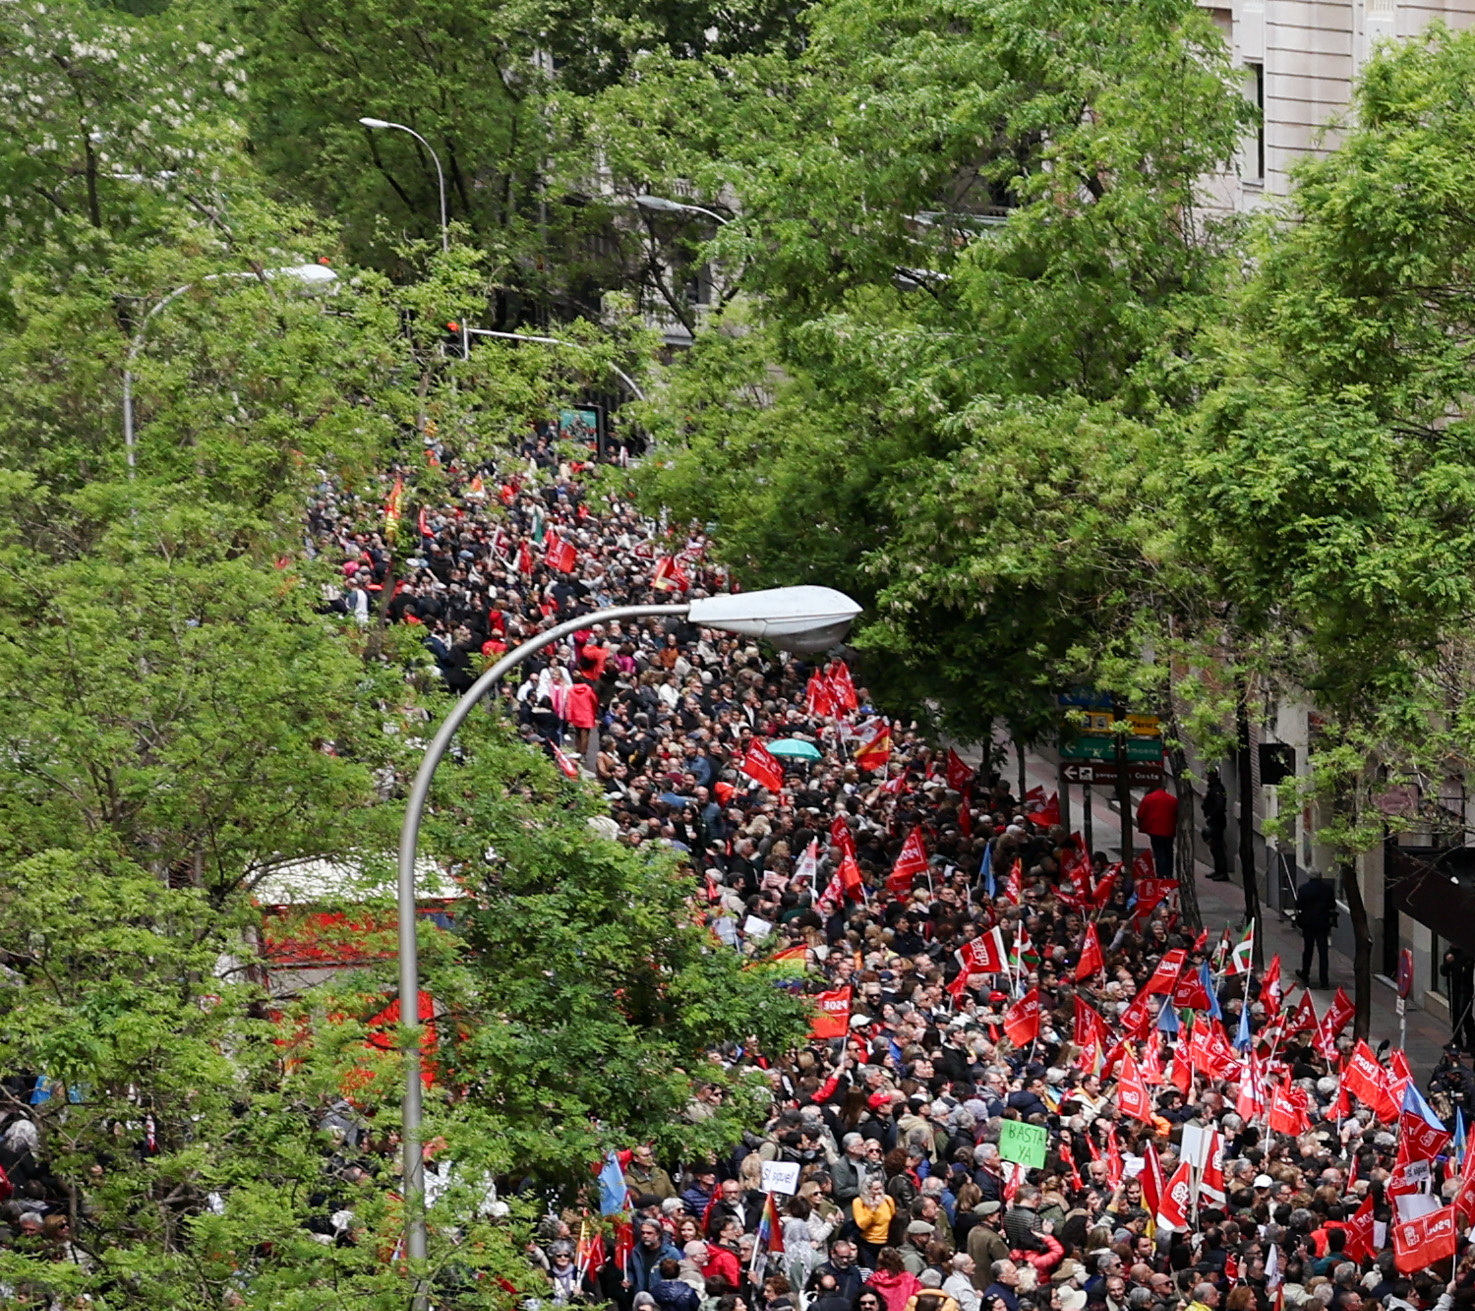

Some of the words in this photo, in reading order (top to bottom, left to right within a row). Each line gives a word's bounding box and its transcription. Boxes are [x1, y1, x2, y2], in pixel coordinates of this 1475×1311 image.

[1354, 1054, 1375, 1074] PSOE
[1009, 1124, 1044, 1145] BASTA
[1018, 1147, 1032, 1160] YA
